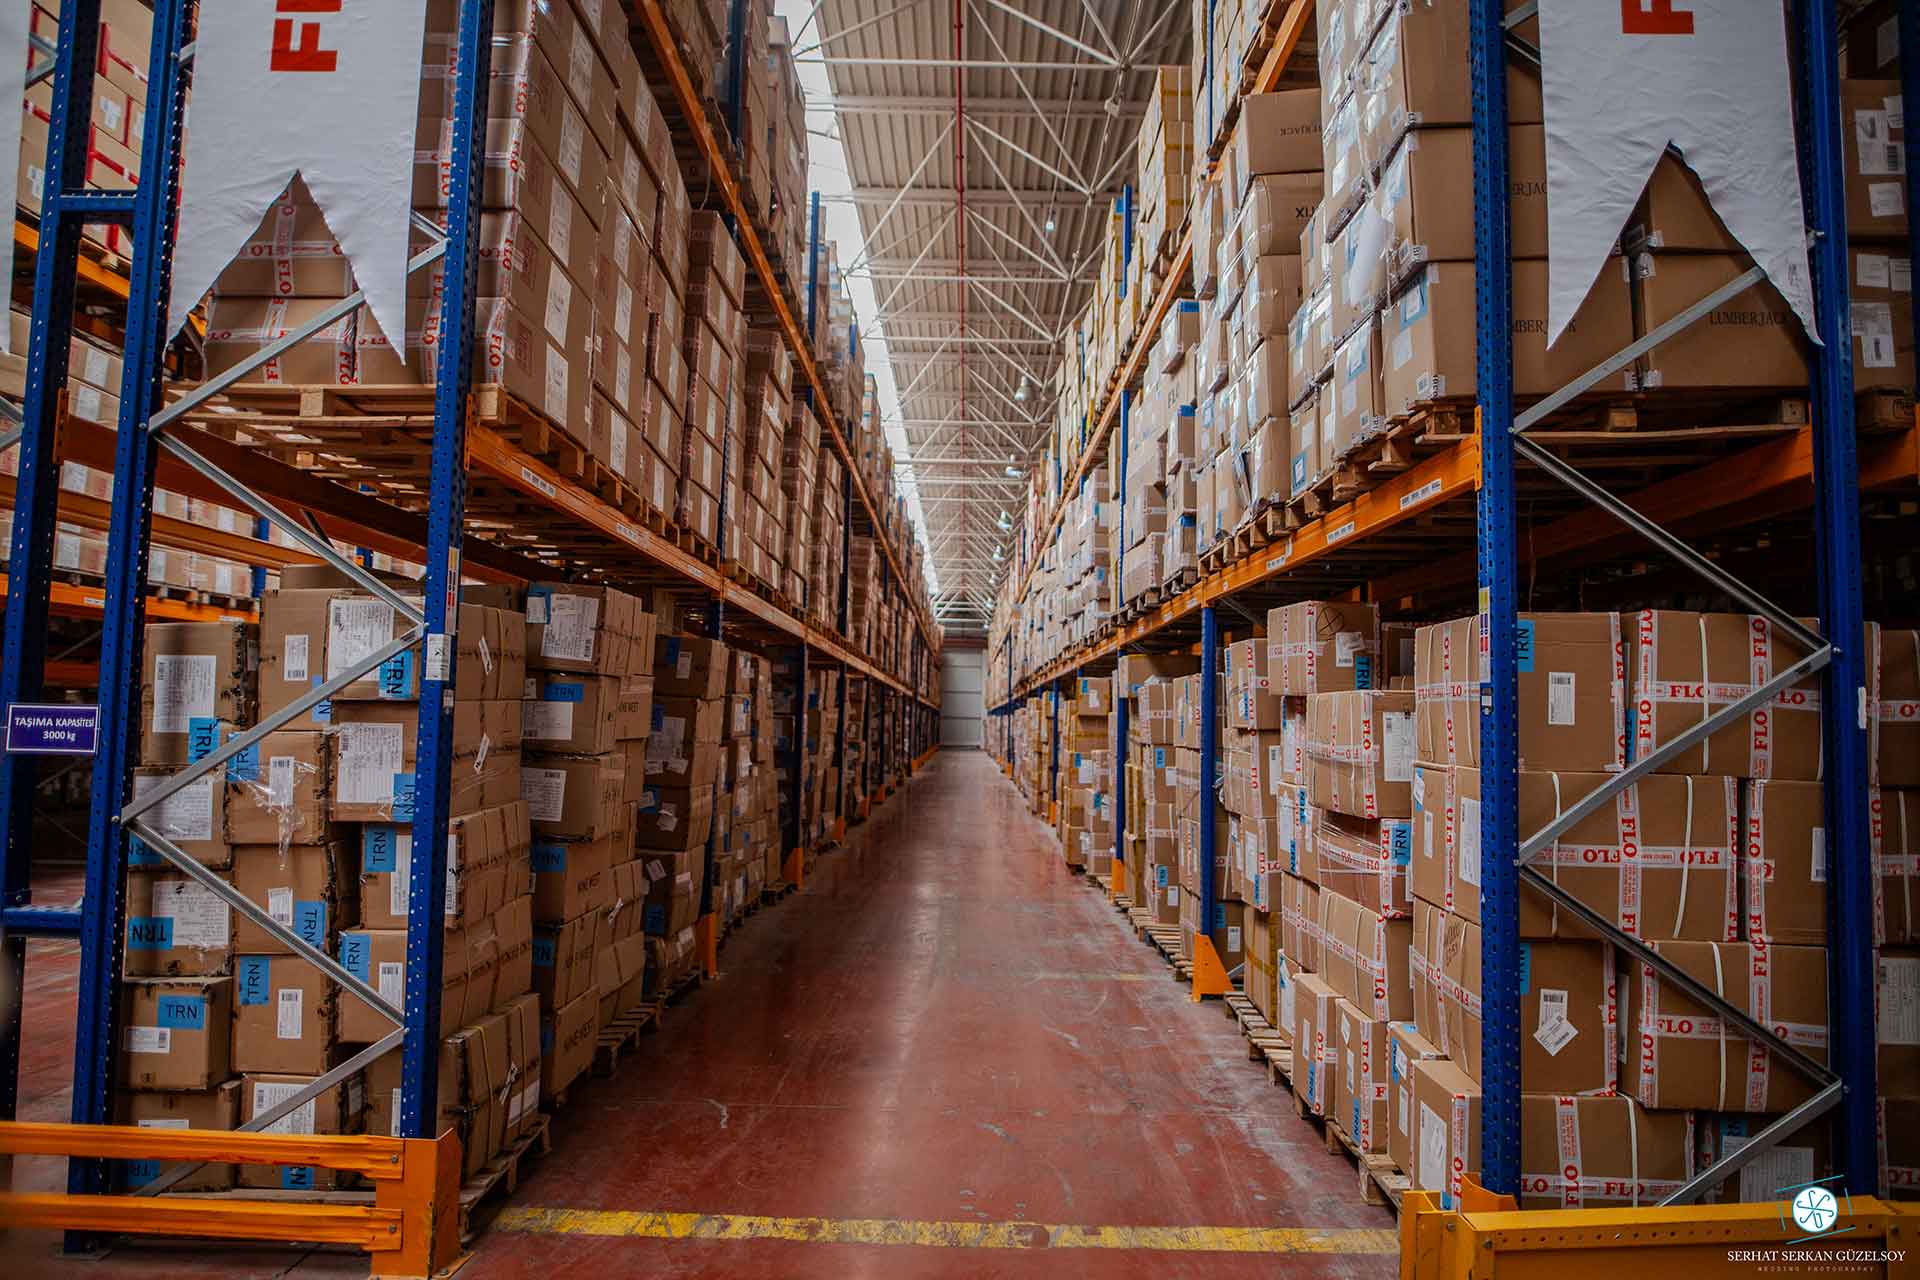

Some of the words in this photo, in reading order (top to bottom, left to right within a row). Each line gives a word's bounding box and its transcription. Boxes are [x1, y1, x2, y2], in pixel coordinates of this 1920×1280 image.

[271, 0, 342, 72] F
[278, 260, 293, 295] FLO
[423, 316, 439, 345] FLO
[489, 334, 502, 367] FLO
[266, 357, 280, 380] FL
[1753, 618, 1767, 658] FLO
[387, 656, 405, 695] TRN
[1357, 656, 1370, 690] TRN
[1451, 685, 1463, 697] LO
[1670, 684, 1710, 699] FLO
[1779, 689, 1806, 705] LO
[15, 717, 53, 728] TAŞIMA
[55, 717, 94, 728] KAPASİTESİ
[1363, 720, 1372, 751] FLO
[1640, 699, 1652, 740] FLO
[1755, 711, 1768, 751] FLO
[43, 731, 65, 740] 3000
[67, 732, 76, 742] kg
[373, 831, 387, 864] TRN
[1382, 828, 1391, 861] FLO
[1394, 828, 1408, 859] TRN
[1622, 816, 1638, 858] FLO
[1749, 818, 1761, 858] FLO
[1583, 848, 1621, 864] FLO
[1680, 851, 1720, 865] FLO
[132, 924, 168, 943] TRN
[303, 909, 318, 941] TRN
[1623, 912, 1636, 933] FL
[347, 942, 361, 973] TRN
[1754, 937, 1768, 977] FLO
[247, 964, 261, 997] TRN
[1375, 967, 1386, 1000] FLO
[167, 1004, 198, 1018] TRN
[1643, 1033, 1655, 1075] FLO
[1453, 1156, 1464, 1200] FLO
[1522, 1178, 1549, 1193] LO
[1564, 1165, 1580, 1206] FLO
[1604, 1181, 1645, 1197] FLO
